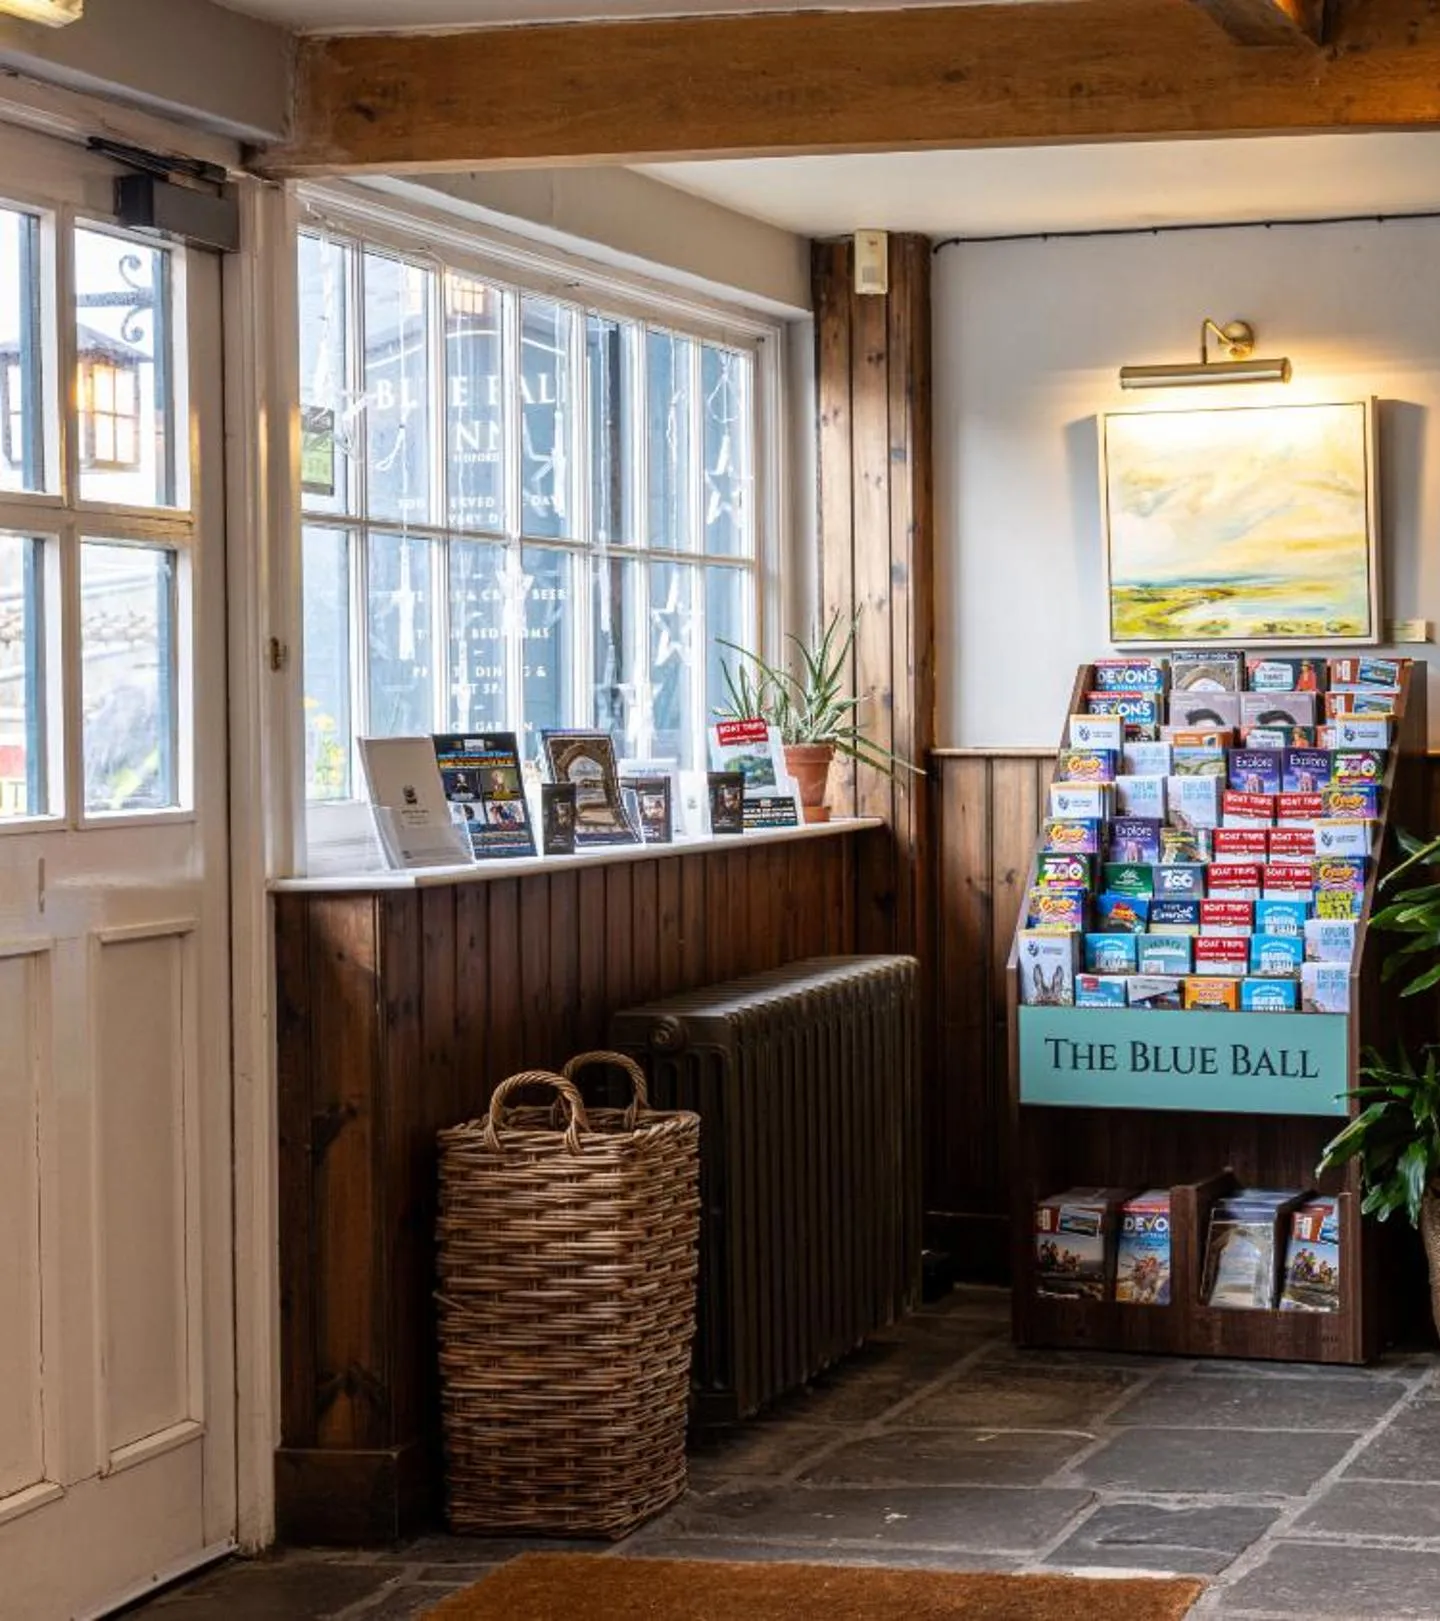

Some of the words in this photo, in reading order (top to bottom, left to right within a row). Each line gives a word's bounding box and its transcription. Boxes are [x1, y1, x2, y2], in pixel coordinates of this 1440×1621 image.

[376, 374, 468, 410] BLE
[1236, 757, 1273, 769] Explore
[1289, 754, 1328, 768] Explore
[1115, 825, 1152, 838] Explore
[1044, 1037, 1118, 1071] THE
[1129, 1040, 1219, 1077] BLUE
[1229, 1043, 1320, 1079] BALL
